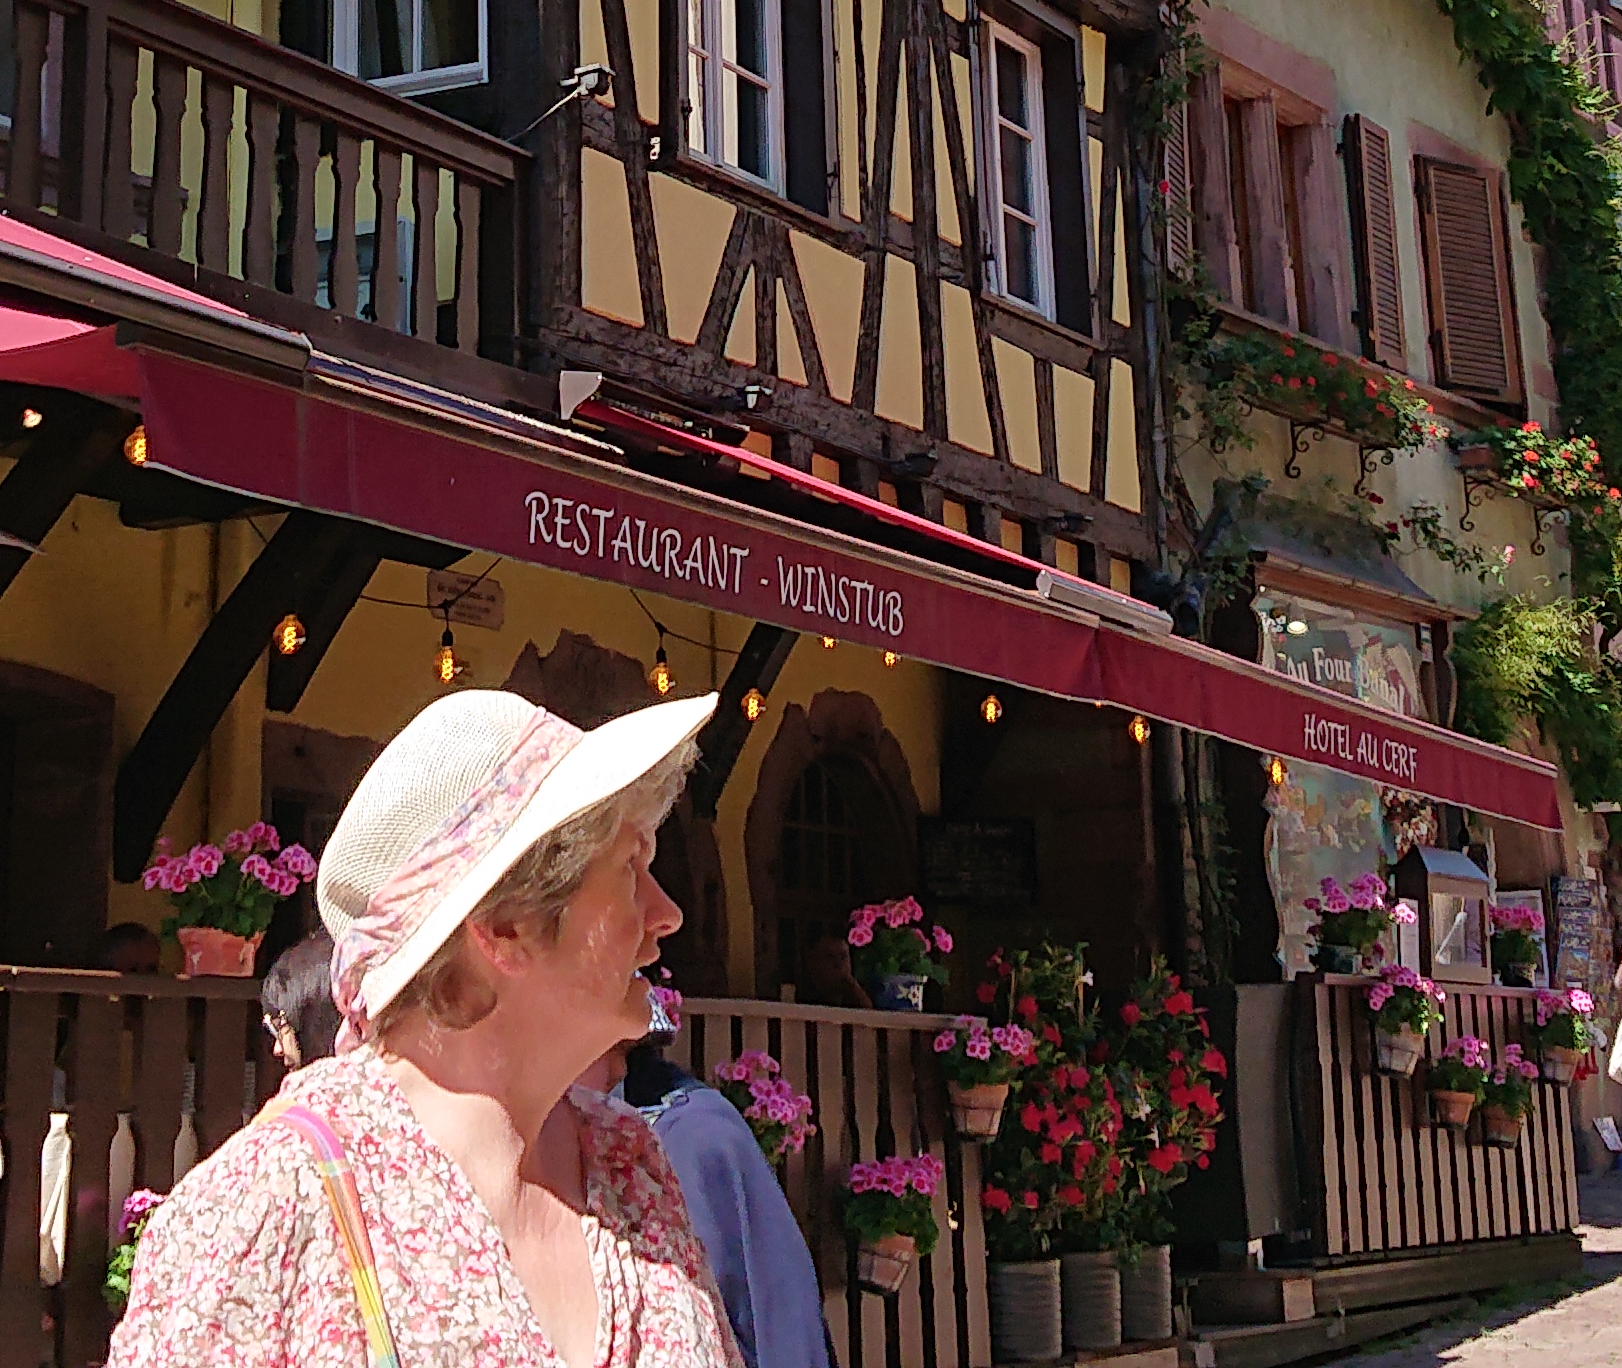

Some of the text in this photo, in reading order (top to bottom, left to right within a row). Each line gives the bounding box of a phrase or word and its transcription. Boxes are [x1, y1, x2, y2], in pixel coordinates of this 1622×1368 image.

[524, 490, 751, 594] RESTAURANT
[776, 555, 904, 636] WINSTUB
[1287, 656, 1310, 683] Au
[1311, 647, 1353, 683] Four
[1304, 713, 1418, 784] HOTEL AU CERF
